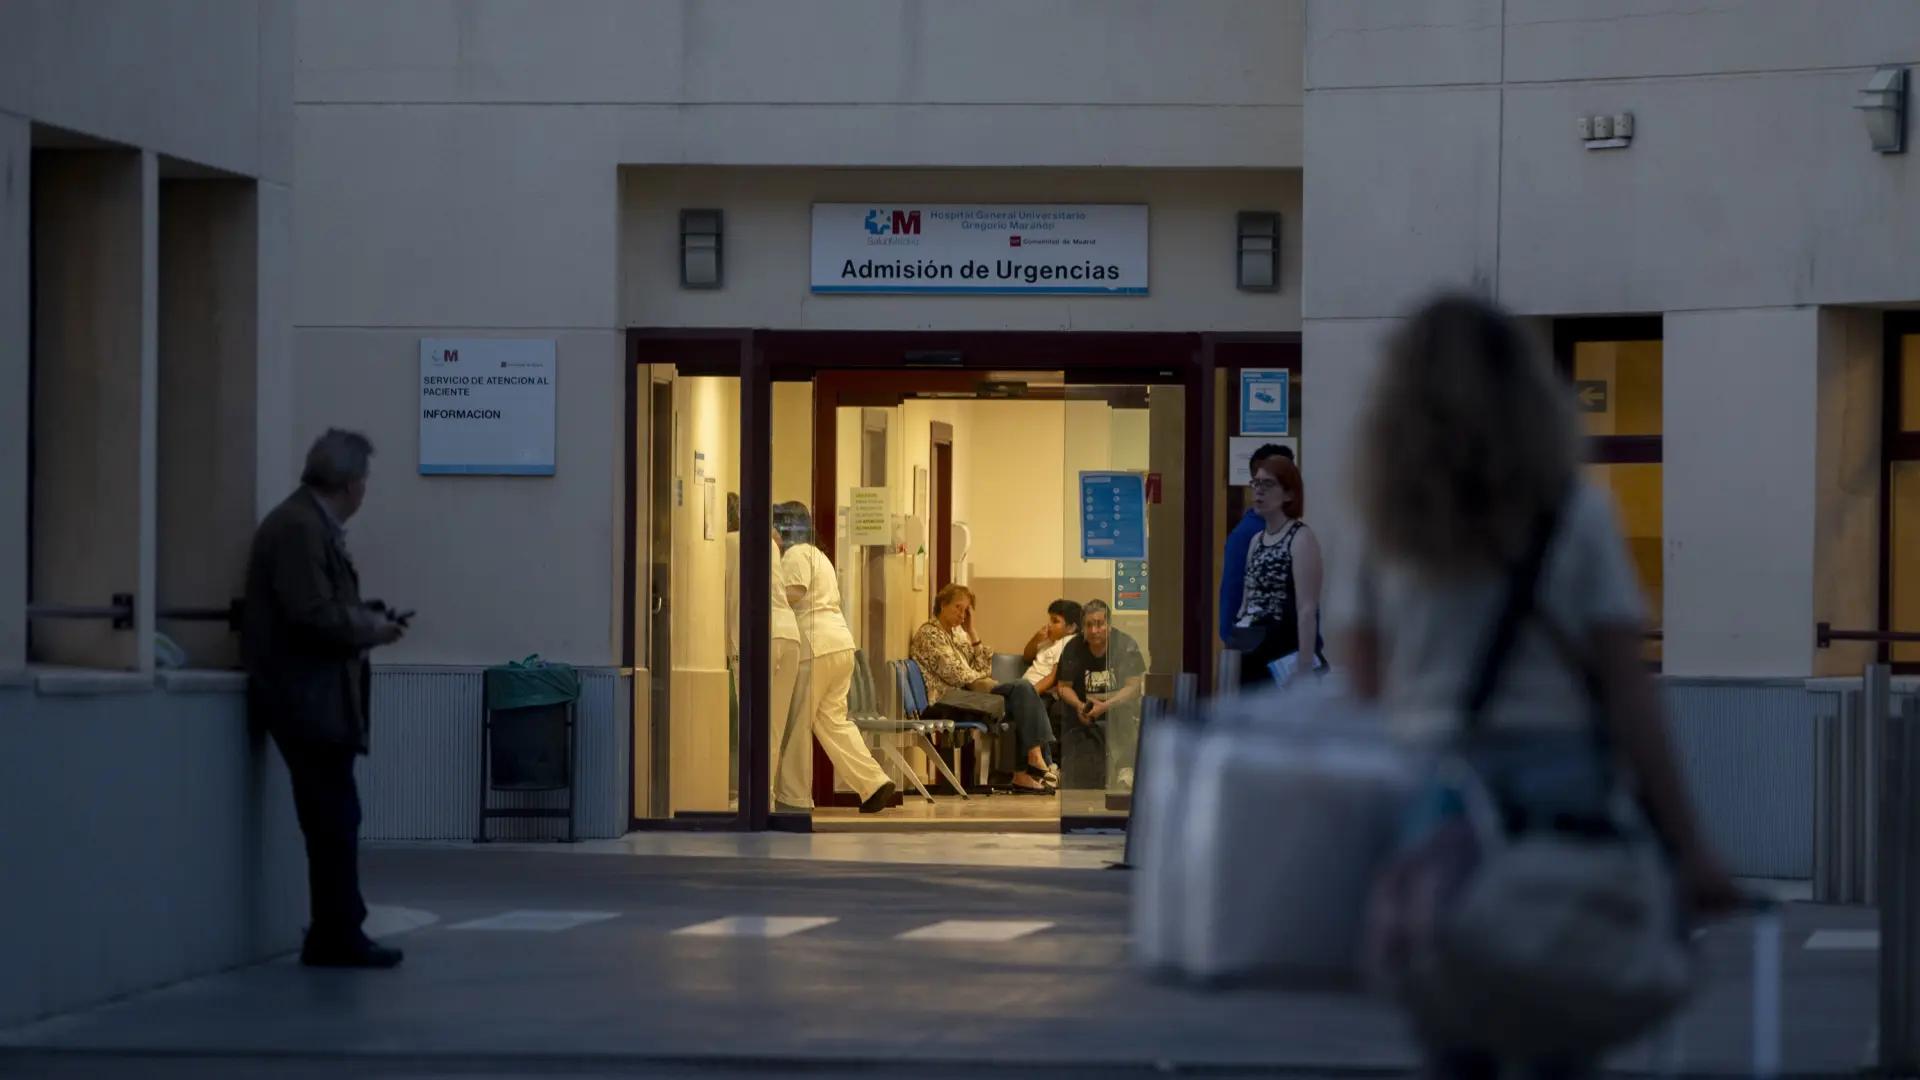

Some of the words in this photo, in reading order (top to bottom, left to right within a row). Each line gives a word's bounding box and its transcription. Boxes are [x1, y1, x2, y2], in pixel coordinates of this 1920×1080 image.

[930, 210, 974, 221] Hospital
[975, 210, 1015, 220] General
[1018, 210, 1086, 220] Universitario
[892, 209, 921, 235] M
[961, 221, 1007, 231] Gregorio
[841, 259, 953, 280] Admisión
[959, 260, 989, 280] de
[996, 260, 1120, 284] Urgencias
[444, 349, 458, 362] M
[423, 376, 470, 386] SERVICIO
[471, 376, 484, 385] DE
[486, 376, 535, 386] ATENCION
[536, 376, 549, 385] AL
[423, 387, 471, 397] PACIENTE
[423, 409, 501, 420] INFORMACION
